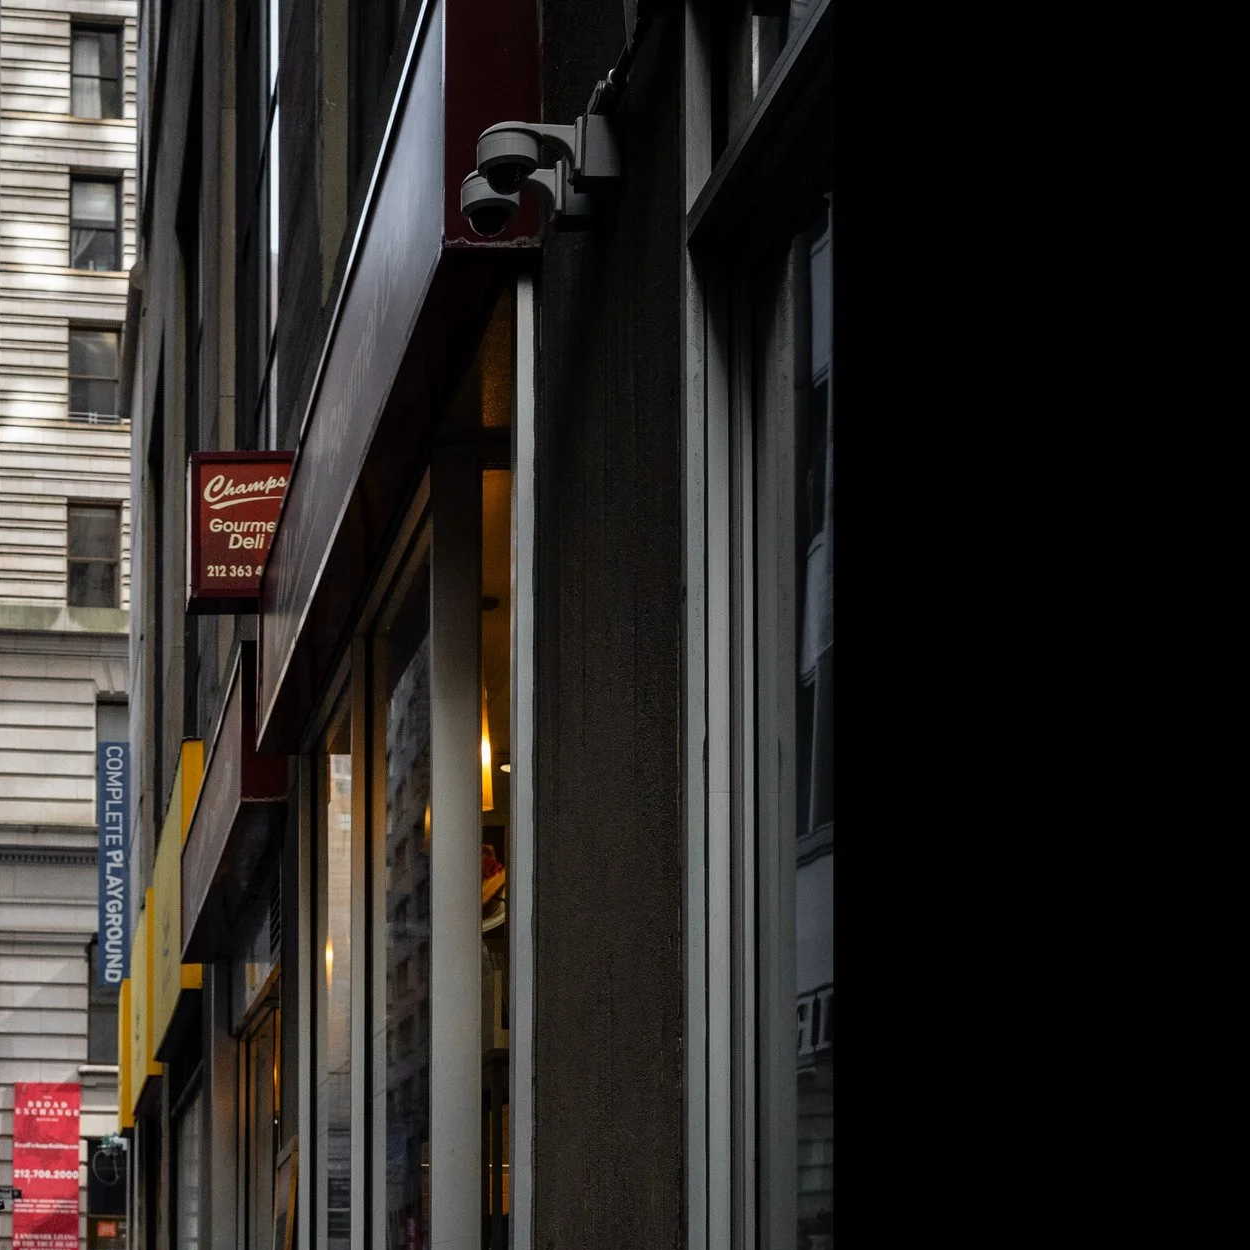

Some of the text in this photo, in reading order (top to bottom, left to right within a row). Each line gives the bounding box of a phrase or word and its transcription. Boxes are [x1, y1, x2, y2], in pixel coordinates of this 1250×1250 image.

[203, 474, 288, 503] Champs
[210, 518, 276, 533] Gourme
[228, 533, 265, 549] Deli
[207, 565, 226, 577] 212
[230, 565, 252, 577] 363
[105, 746, 124, 984] COMPLETE PLAYGROUND
[15, 1107, 80, 1117] EXCHANGE
[27, 1100, 69, 1109] BROAD
